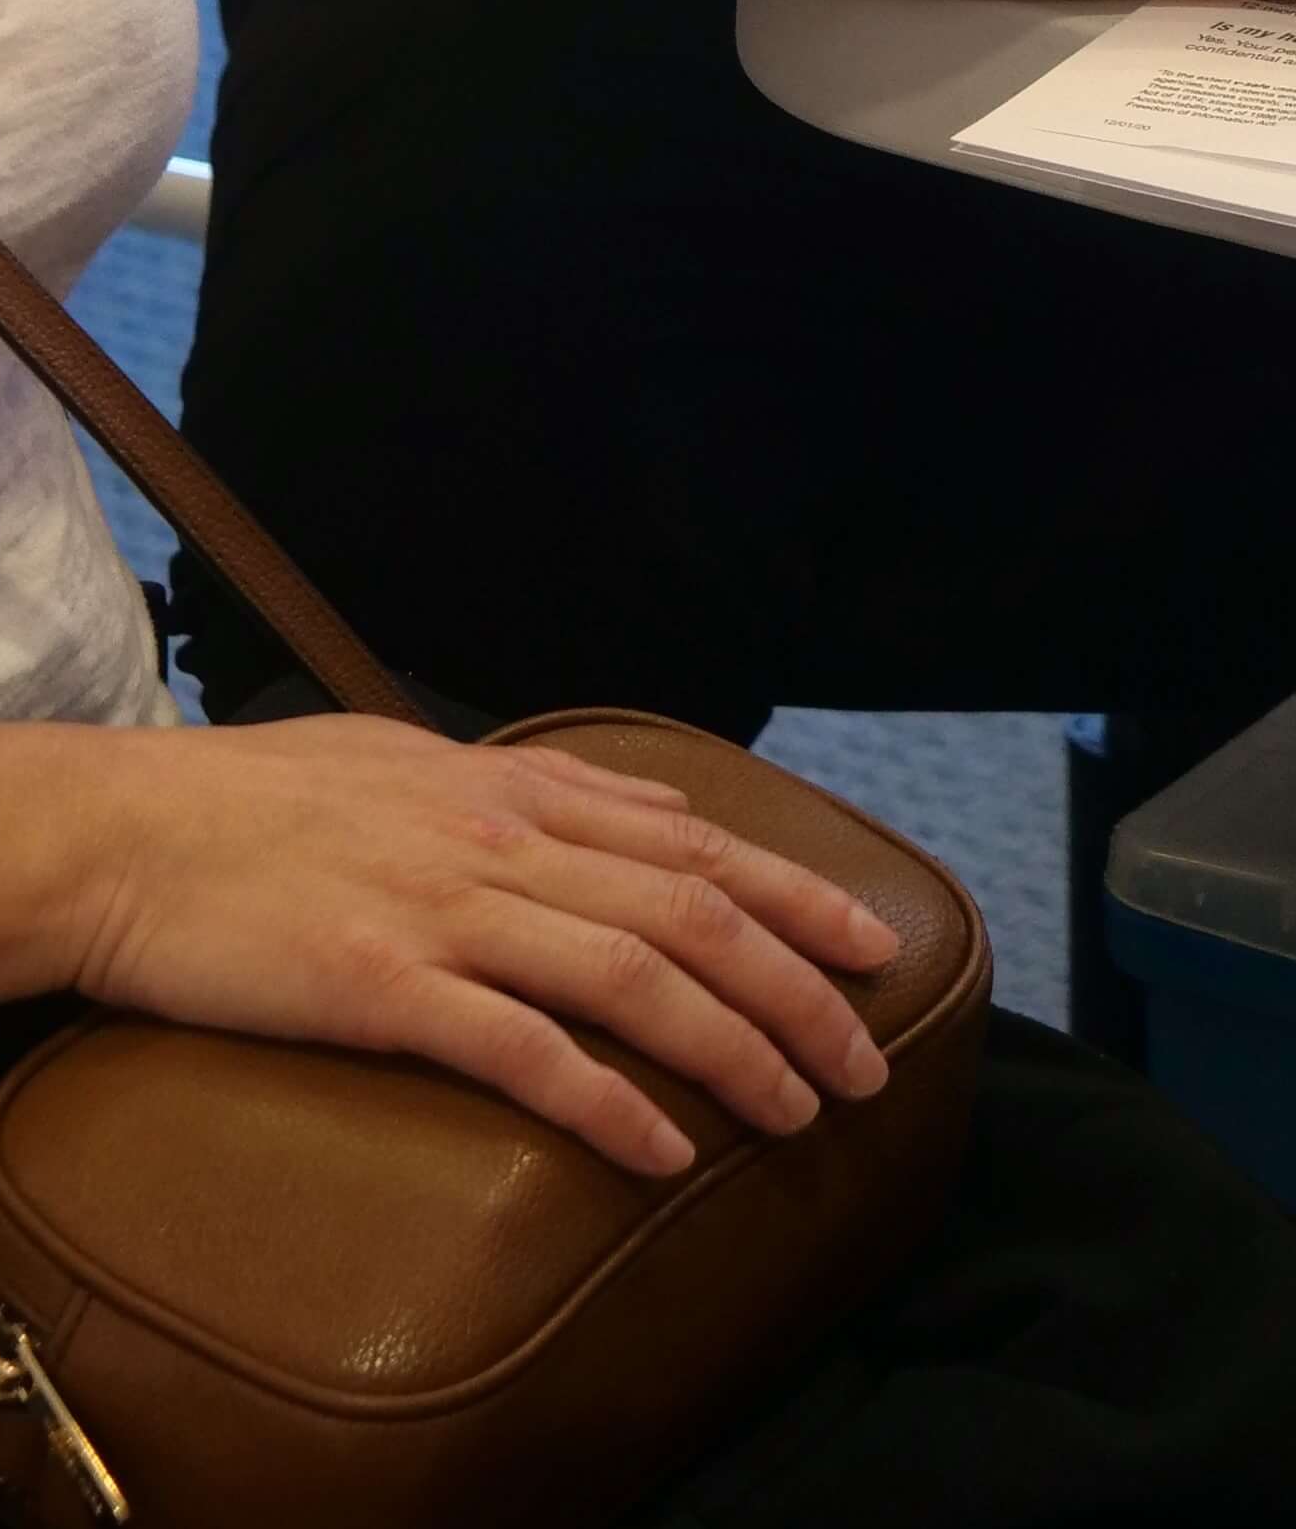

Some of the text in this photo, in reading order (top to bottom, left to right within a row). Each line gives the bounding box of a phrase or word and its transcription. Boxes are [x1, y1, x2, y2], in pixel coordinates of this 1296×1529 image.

[1210, 21, 1235, 32] Is
[1236, 26, 1276, 39] my
[1184, 43, 1283, 64] confidential
[1236, 39, 1273, 52] Your
